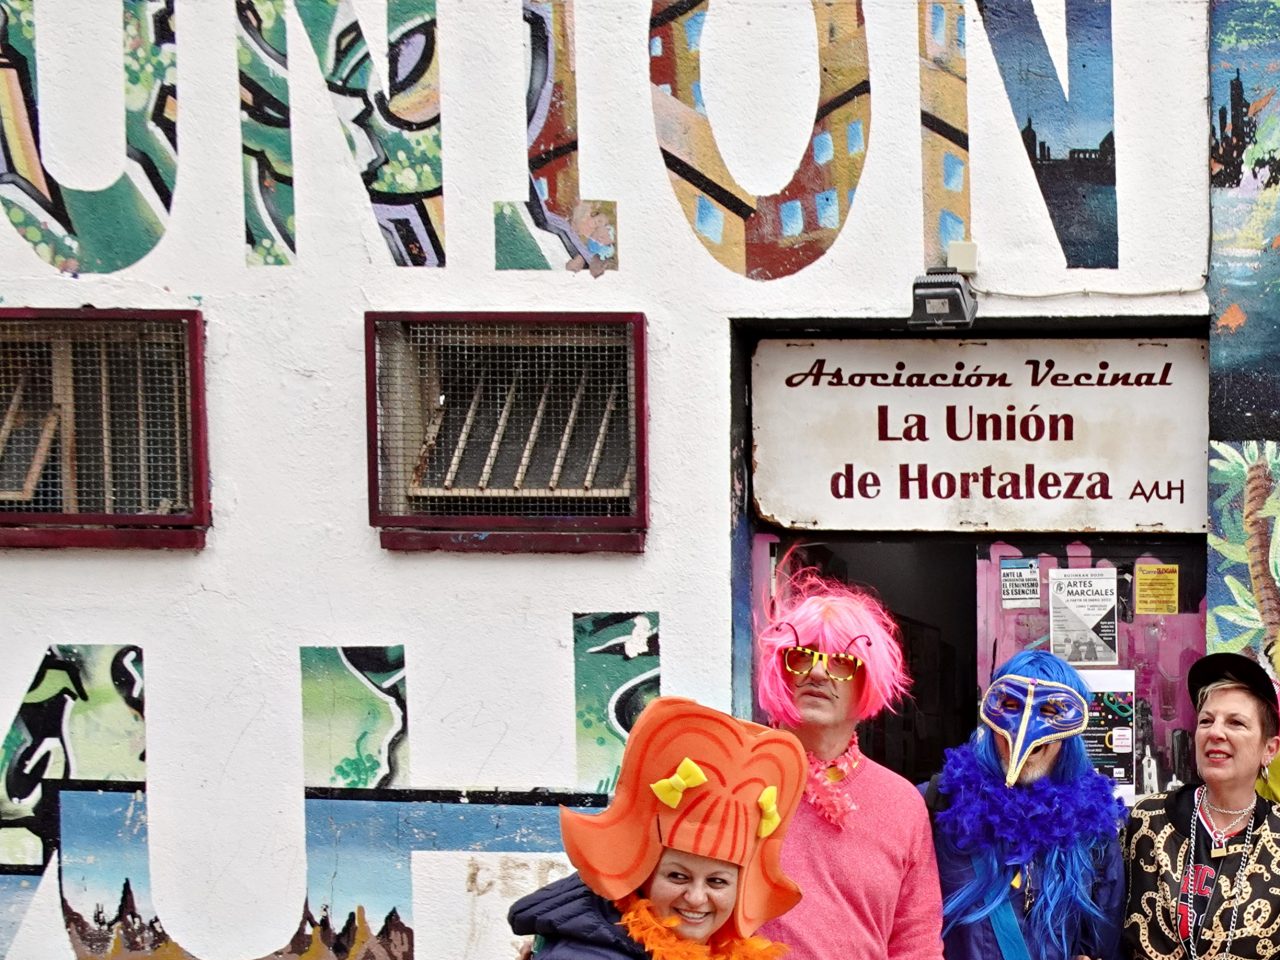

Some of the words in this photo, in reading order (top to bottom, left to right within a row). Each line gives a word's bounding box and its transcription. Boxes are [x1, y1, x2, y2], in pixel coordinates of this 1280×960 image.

[785, 359, 1013, 388] Asociación
[1025, 359, 1174, 388] Vecinal
[877, 404, 929, 442] La
[945, 404, 1075, 442] Unión
[830, 463, 881, 500] de
[899, 463, 1113, 500] Hortaleza
[1011, 588, 1038, 596] ESENCIAL
[1066, 580, 1093, 588] ARTES
[1066, 588, 1115, 597] MARCIALES
